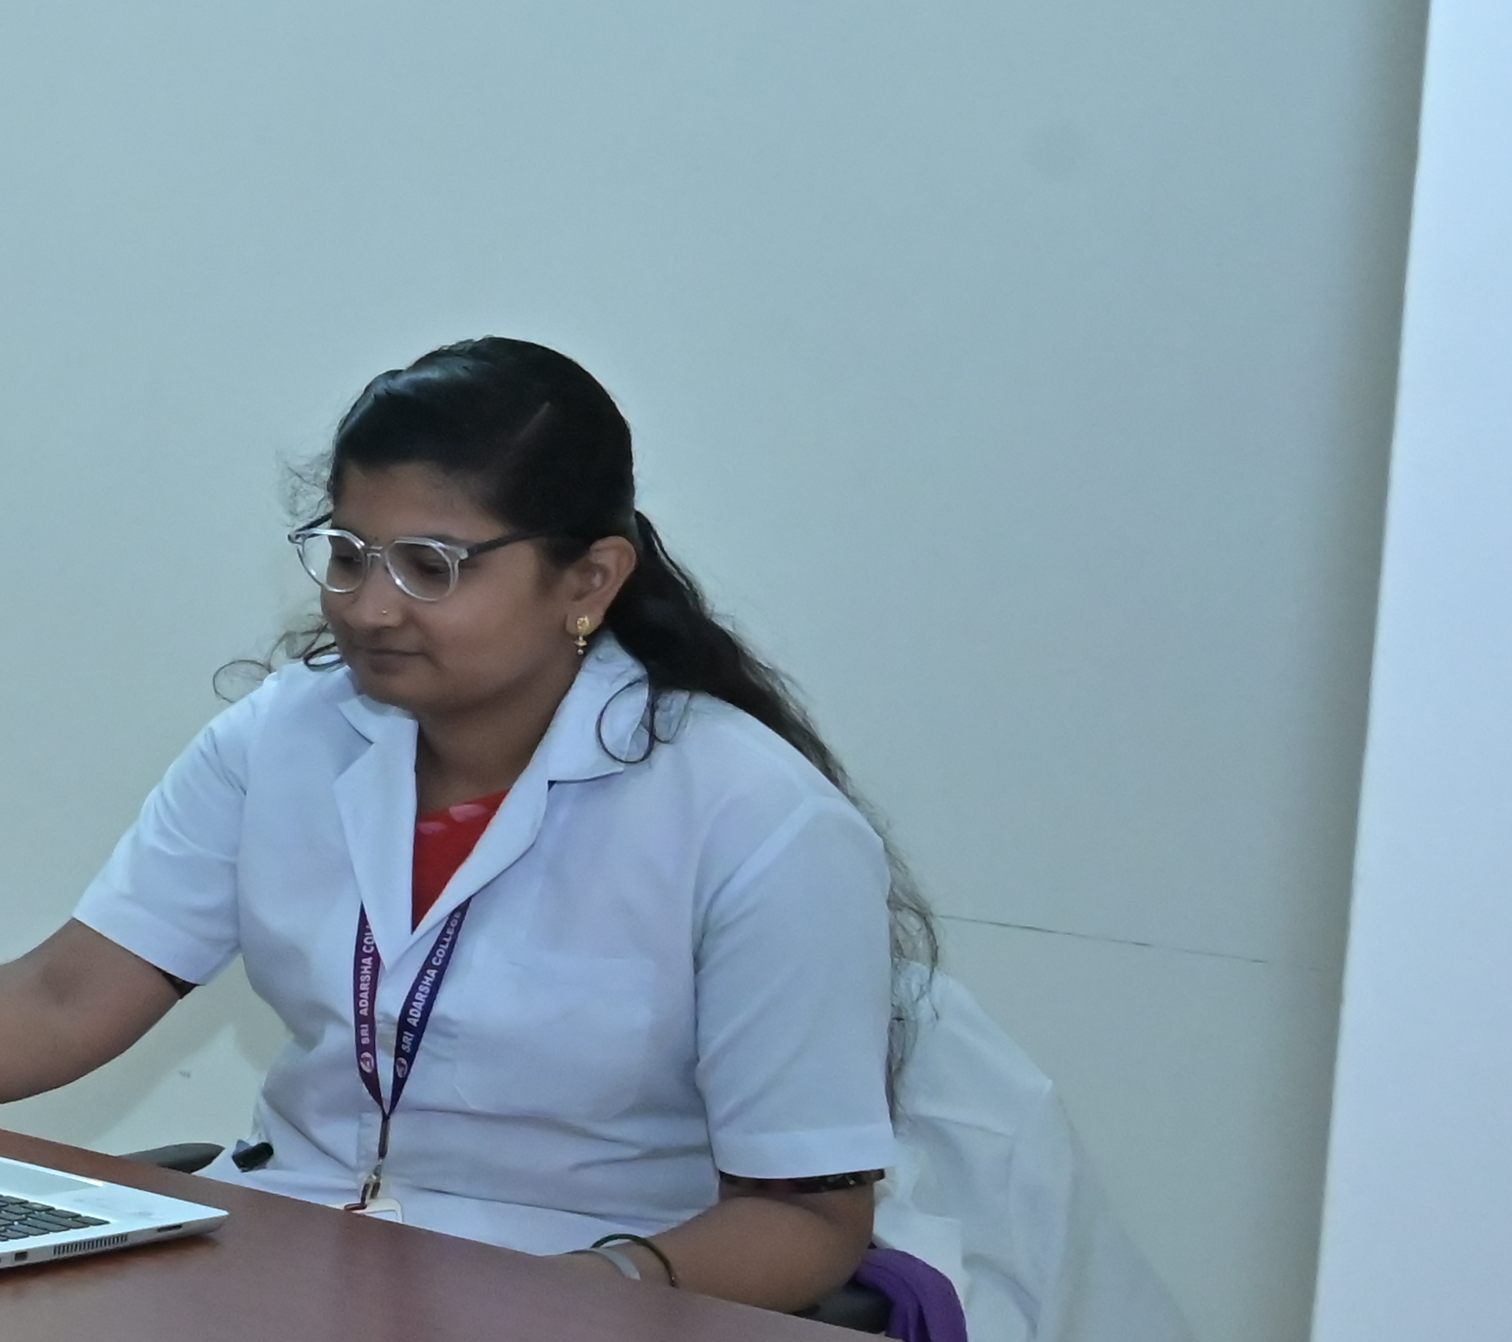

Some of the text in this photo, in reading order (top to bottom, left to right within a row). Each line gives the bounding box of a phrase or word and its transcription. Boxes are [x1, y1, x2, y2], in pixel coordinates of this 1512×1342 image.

[358, 956, 373, 1016] ADARSHA
[401, 911, 462, 1054] SRI ADARSHA COLLEGE
[361, 1024, 371, 1045] SRI
